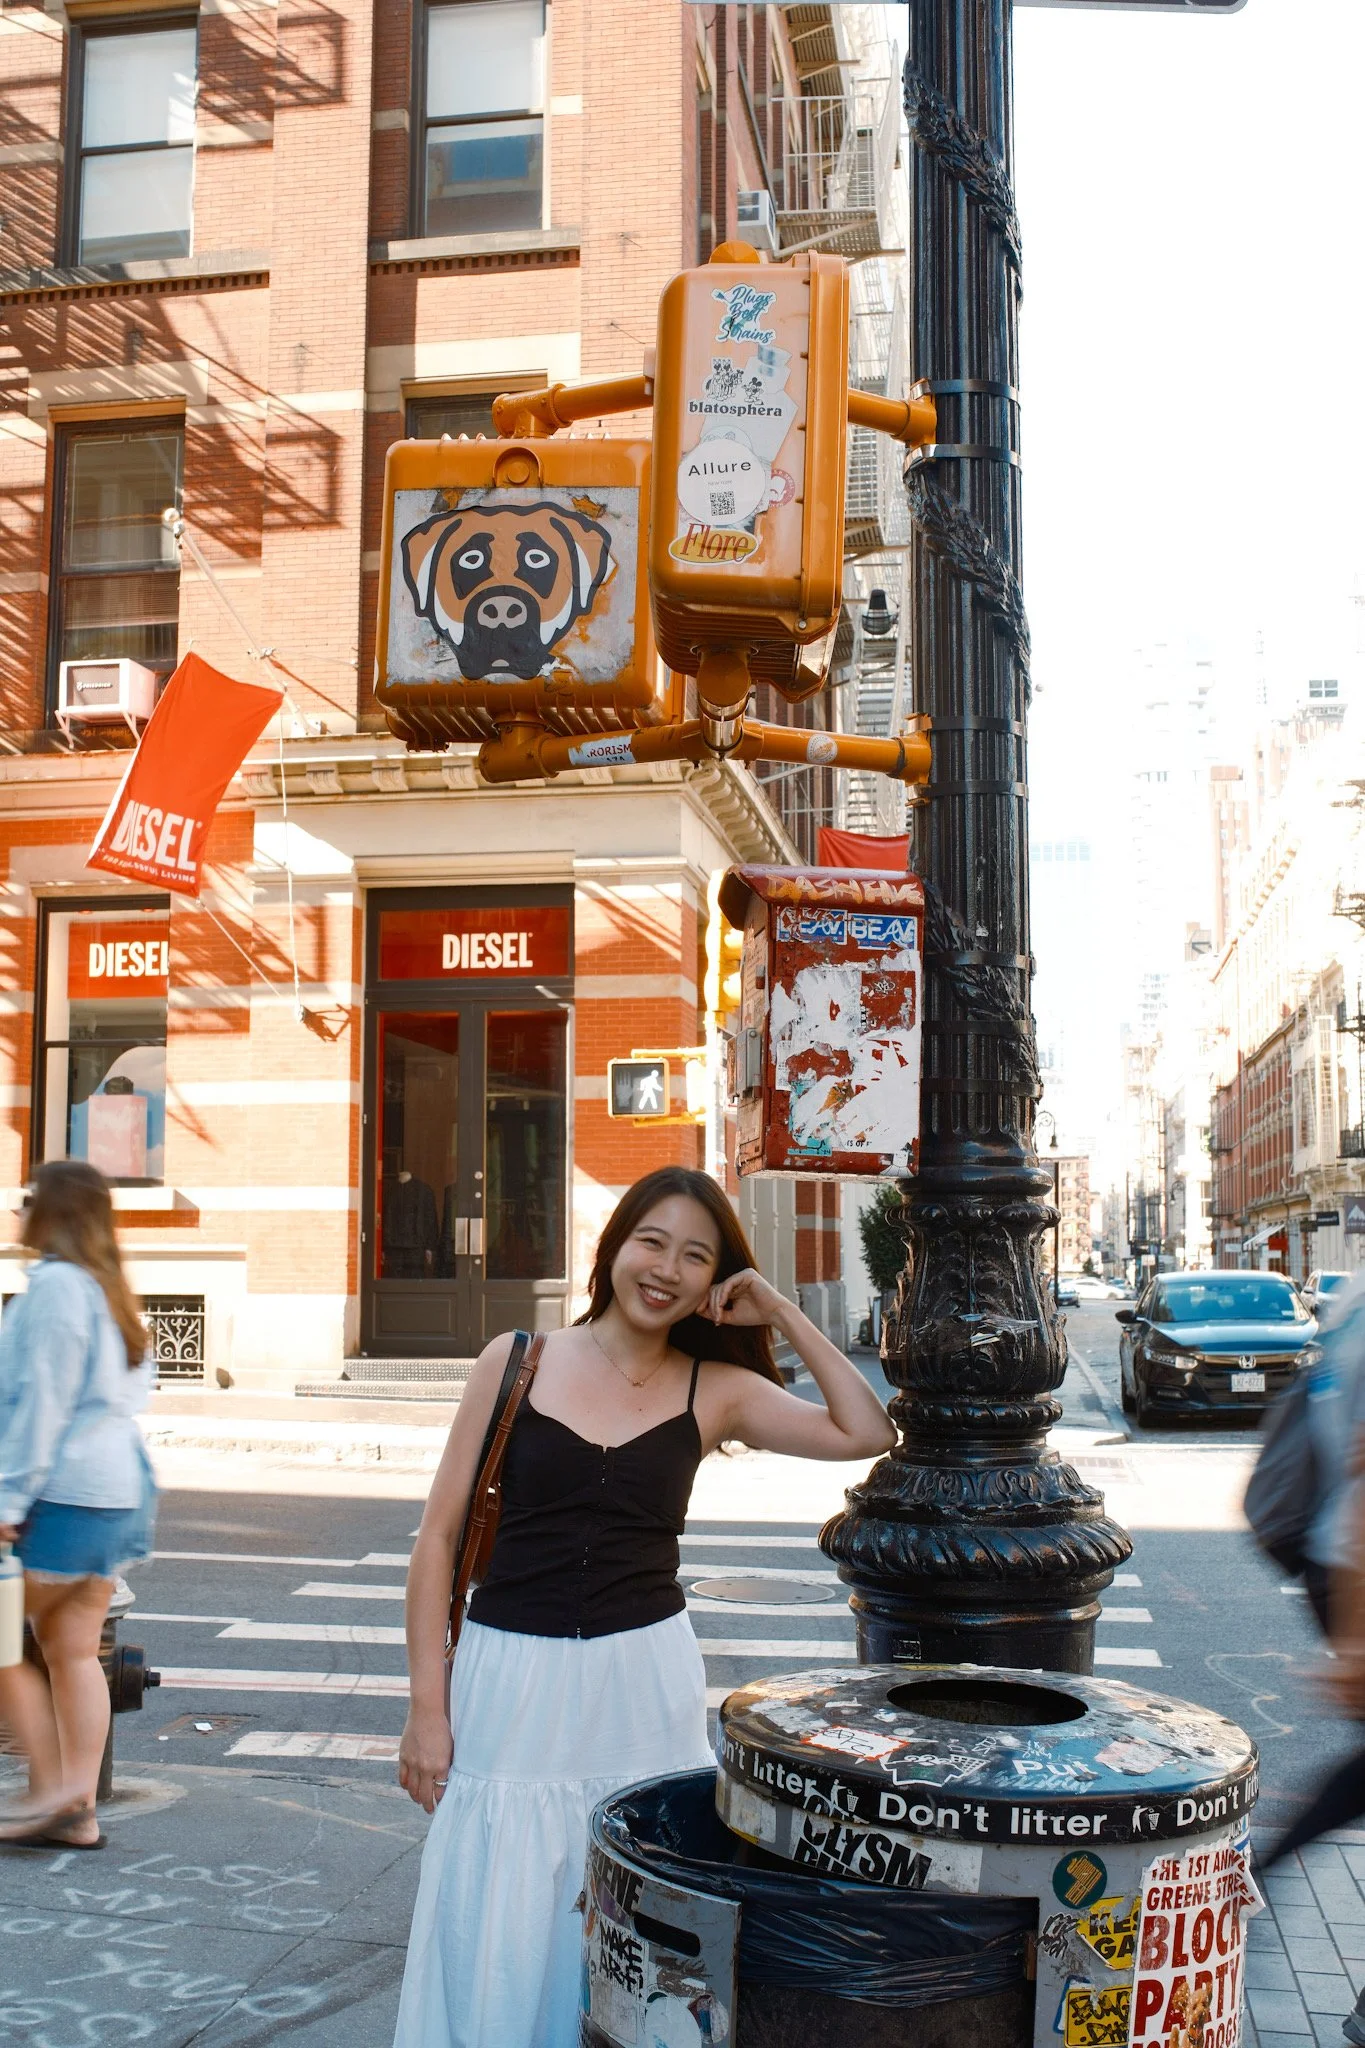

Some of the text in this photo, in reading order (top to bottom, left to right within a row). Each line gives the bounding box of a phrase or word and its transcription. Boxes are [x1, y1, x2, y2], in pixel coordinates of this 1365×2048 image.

[731, 286, 773, 308] Plugs
[730, 303, 765, 323] Best
[689, 401, 782, 417] blatosphera
[688, 461, 752, 477] Allure
[680, 522, 749, 563] Flore
[586, 743, 632, 759] RORISM
[110, 800, 197, 872] DIESEL
[160, 870, 196, 884] LIVING
[442, 931, 534, 970] DIESEL
[753, 1751, 817, 1798] litter
[878, 1791, 990, 1833] Don't
[1010, 1806, 1108, 1837] litter
[1176, 1784, 1240, 1827] Don't
[1188, 1853, 1211, 1879] 1ST
[1146, 1880, 1212, 1912] GREENE
[0, 1907, 192, 1949] OUL
[1138, 1897, 1251, 1972] BLOCK
